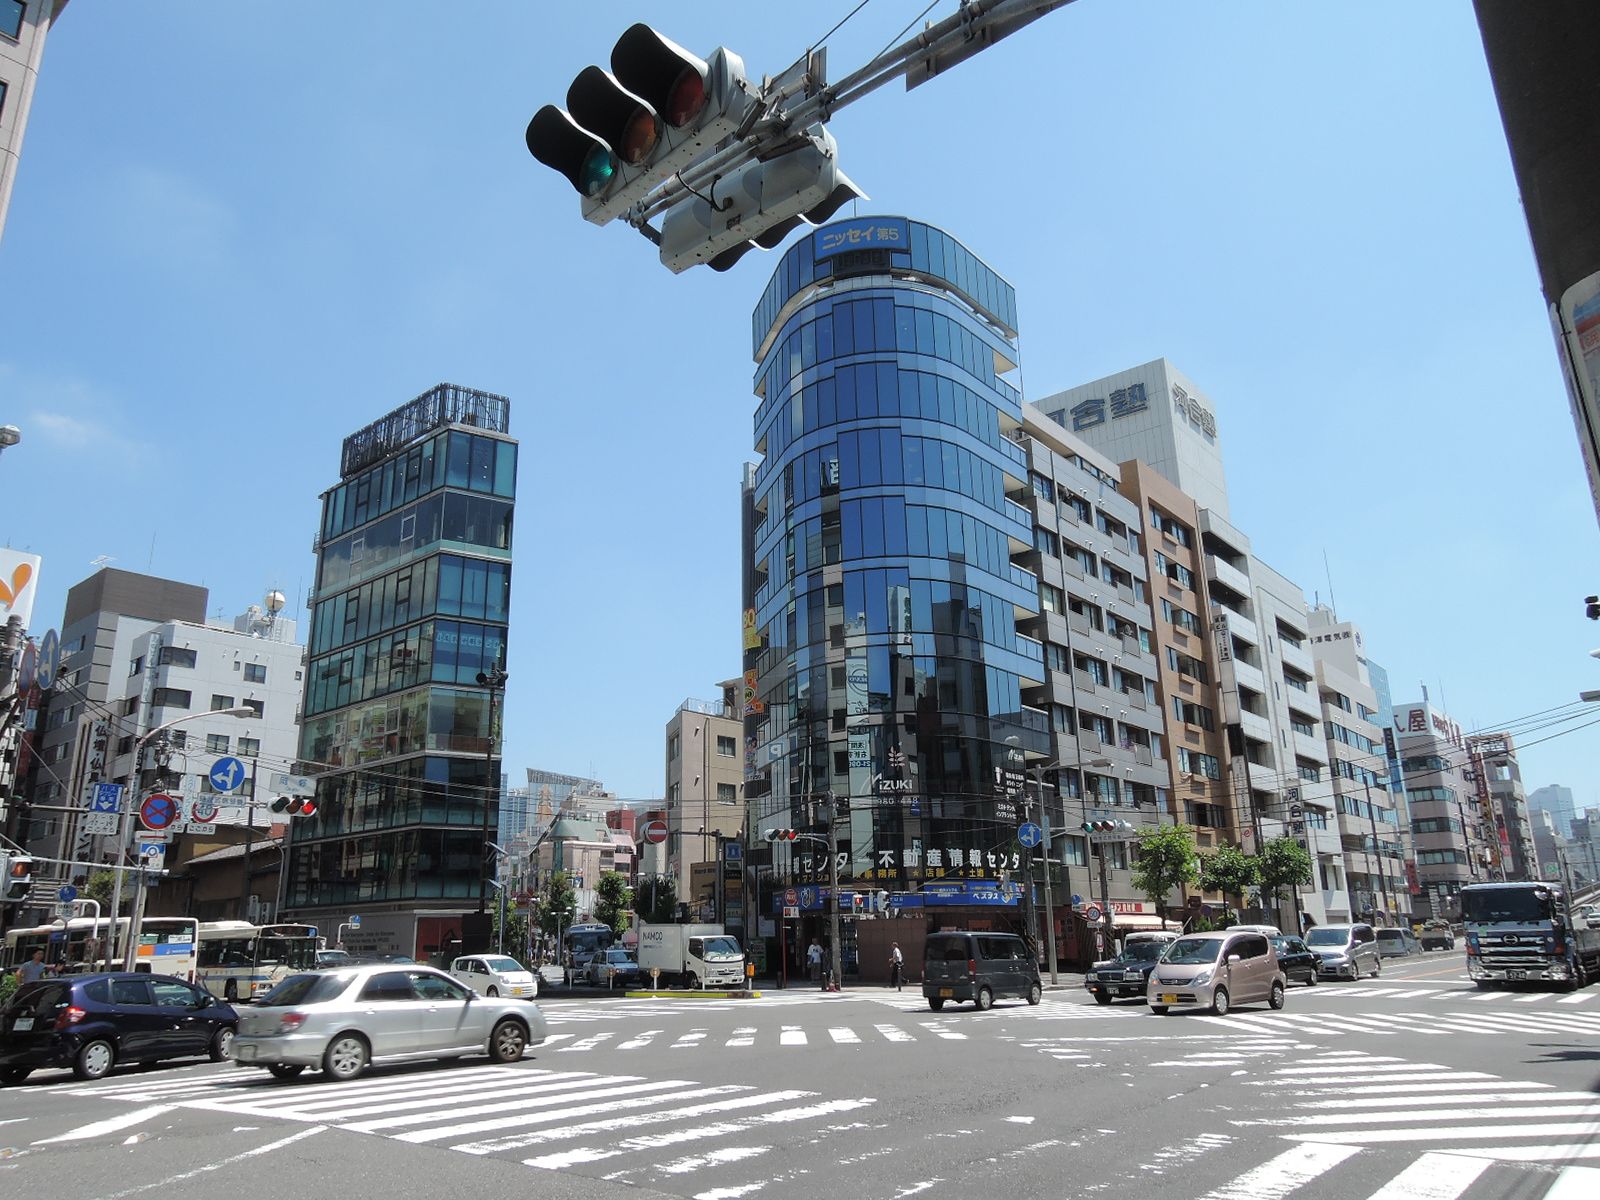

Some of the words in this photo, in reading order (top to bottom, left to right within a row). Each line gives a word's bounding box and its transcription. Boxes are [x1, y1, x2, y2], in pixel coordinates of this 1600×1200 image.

[1172, 383, 1216, 438] 河合塾
[643, 931, 663, 940] NAMCO
